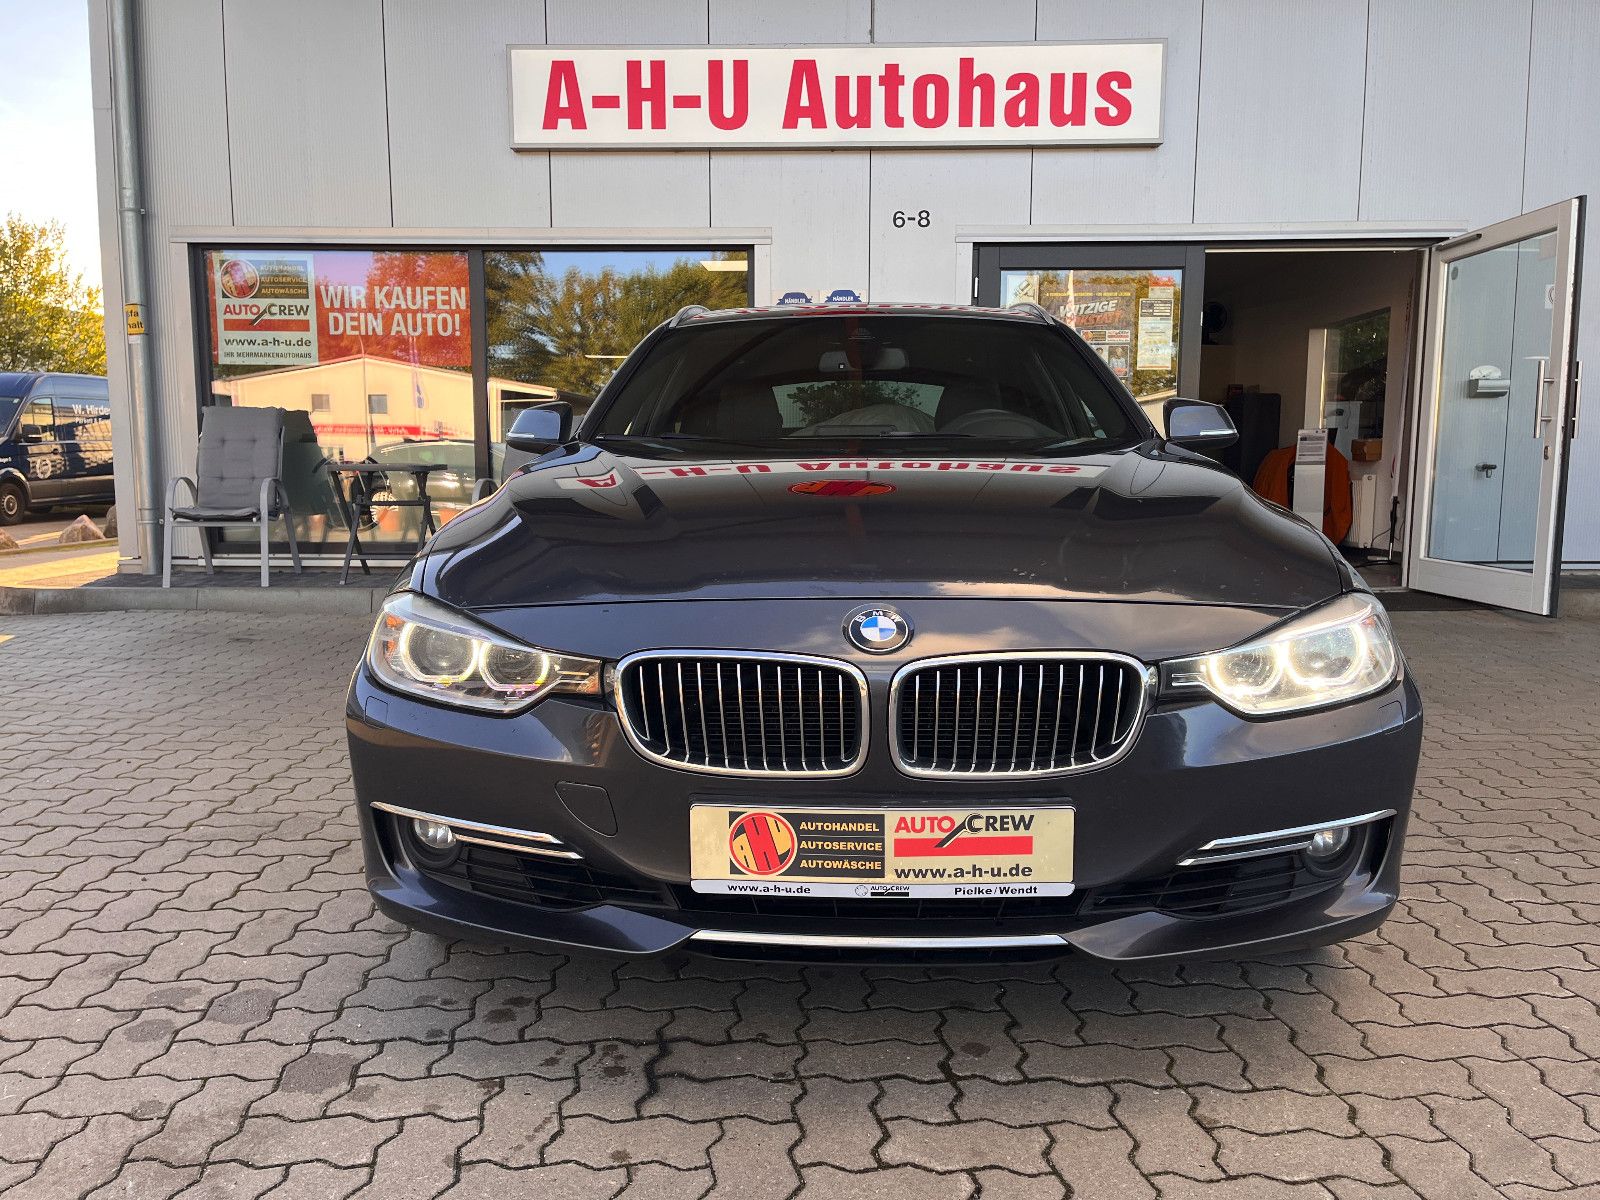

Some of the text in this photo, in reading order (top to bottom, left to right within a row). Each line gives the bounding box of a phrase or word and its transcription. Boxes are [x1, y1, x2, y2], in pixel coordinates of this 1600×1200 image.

[542, 57, 1133, 130] A-H-U Autohaus
[892, 210, 931, 228] 6-8
[320, 285, 466, 310] WIR KAUFEN
[223, 303, 310, 316] AUTO CREW
[328, 312, 461, 337] DEIN AUTO!
[224, 337, 312, 347] www.a-h-u.de
[236, 351, 312, 359] MEHRMARKENAUTOHAUS
[800, 821, 880, 832] AUTOHANDEL
[894, 813, 1034, 834] AUTO CREW
[800, 840, 883, 851] AUTOSERVICE
[800, 858, 882, 870] AUTOWÄSCHE
[894, 863, 1033, 879] www.a-h-u.de
[727, 884, 811, 894] www.a-h-u.de
